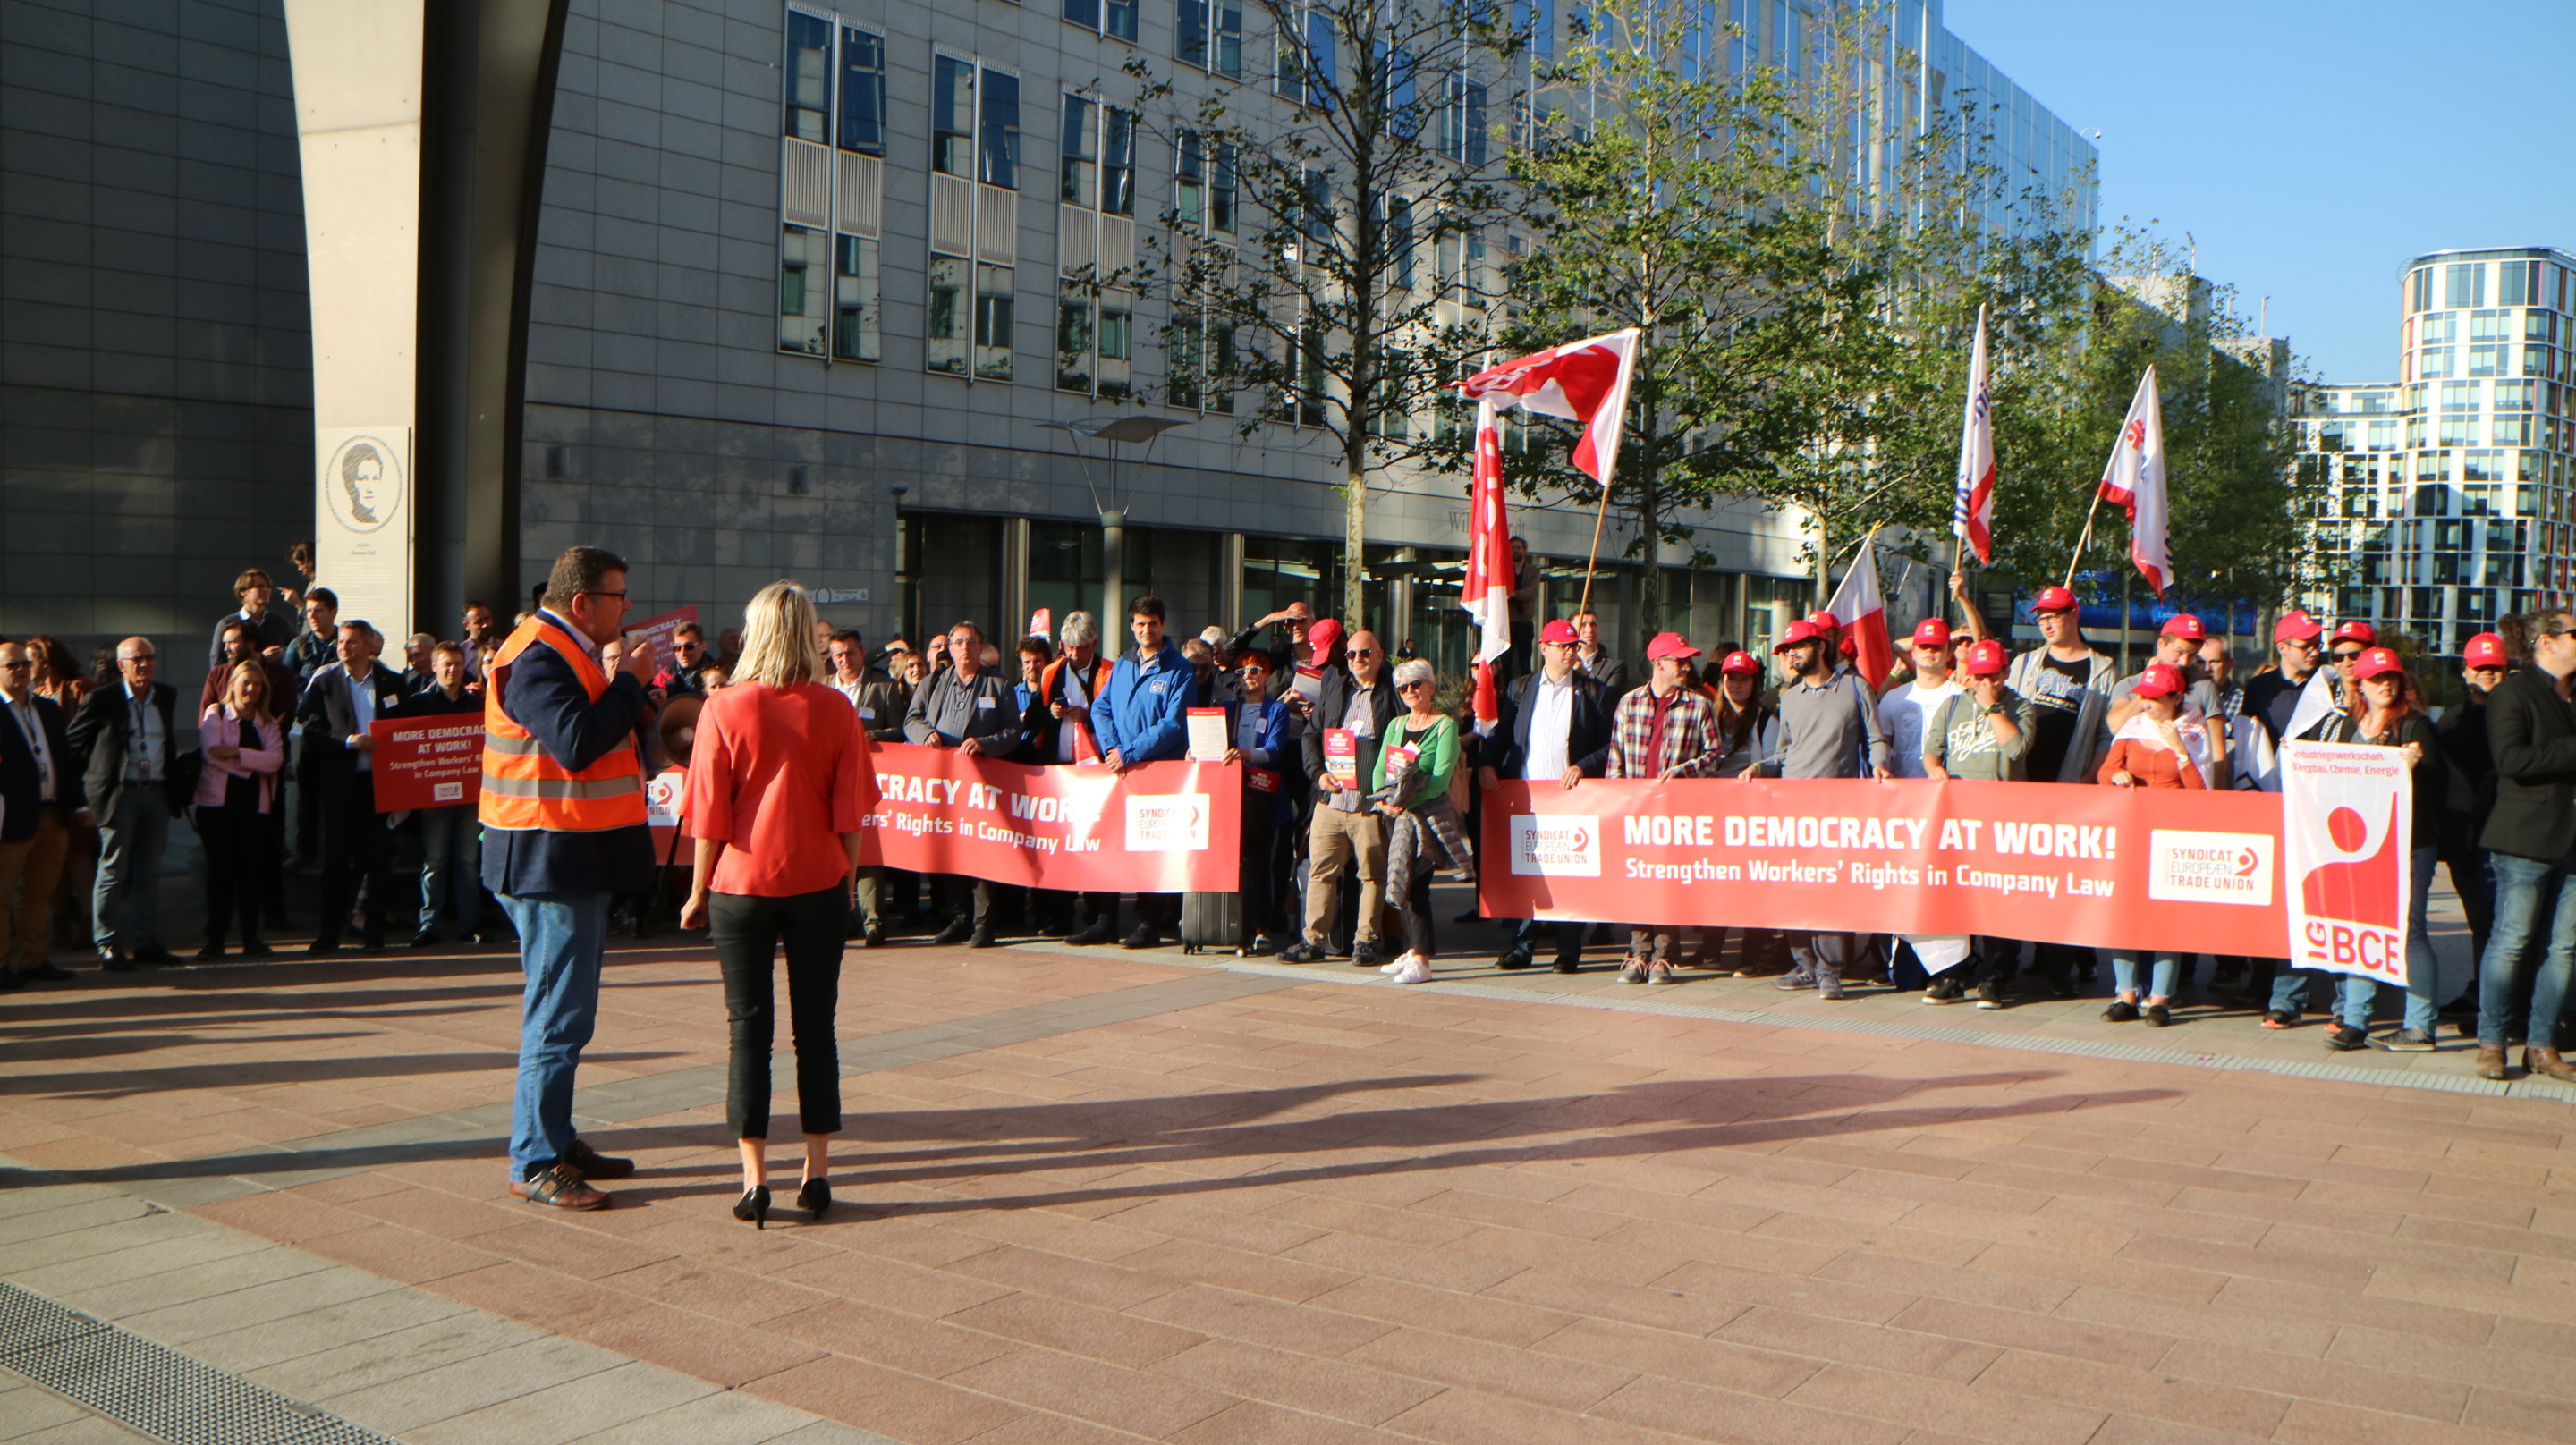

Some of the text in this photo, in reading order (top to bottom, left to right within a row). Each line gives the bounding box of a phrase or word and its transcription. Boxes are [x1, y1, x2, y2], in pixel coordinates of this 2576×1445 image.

[393, 725, 485, 742] MORE DEMOCRAC
[418, 739, 472, 755] AT WORK!
[390, 757, 436, 770] Strengthen
[2329, 765, 2362, 775] Chemie,
[2365, 766, 2400, 777] Energie
[424, 768, 461, 779] Company
[462, 766, 479, 774] Law
[876, 773, 961, 805] CRACY
[968, 782, 1002, 811] AT
[862, 809, 893, 827] ers'
[896, 812, 953, 836] Rights
[960, 817, 973, 837] in
[978, 821, 1059, 856] Company
[1525, 830, 1570, 840] SYNDICAT
[1624, 815, 2116, 859] MORE DEMOCRACY AT WORK!
[1525, 853, 1588, 864] TRADE UNION
[2172, 848, 2233, 862] SYNDICAT
[1626, 857, 2114, 898] Strengthen Workers' Rights in Company Law
[2170, 875, 2254, 891] TRADE UNION
[2332, 925, 2399, 976] BCE
